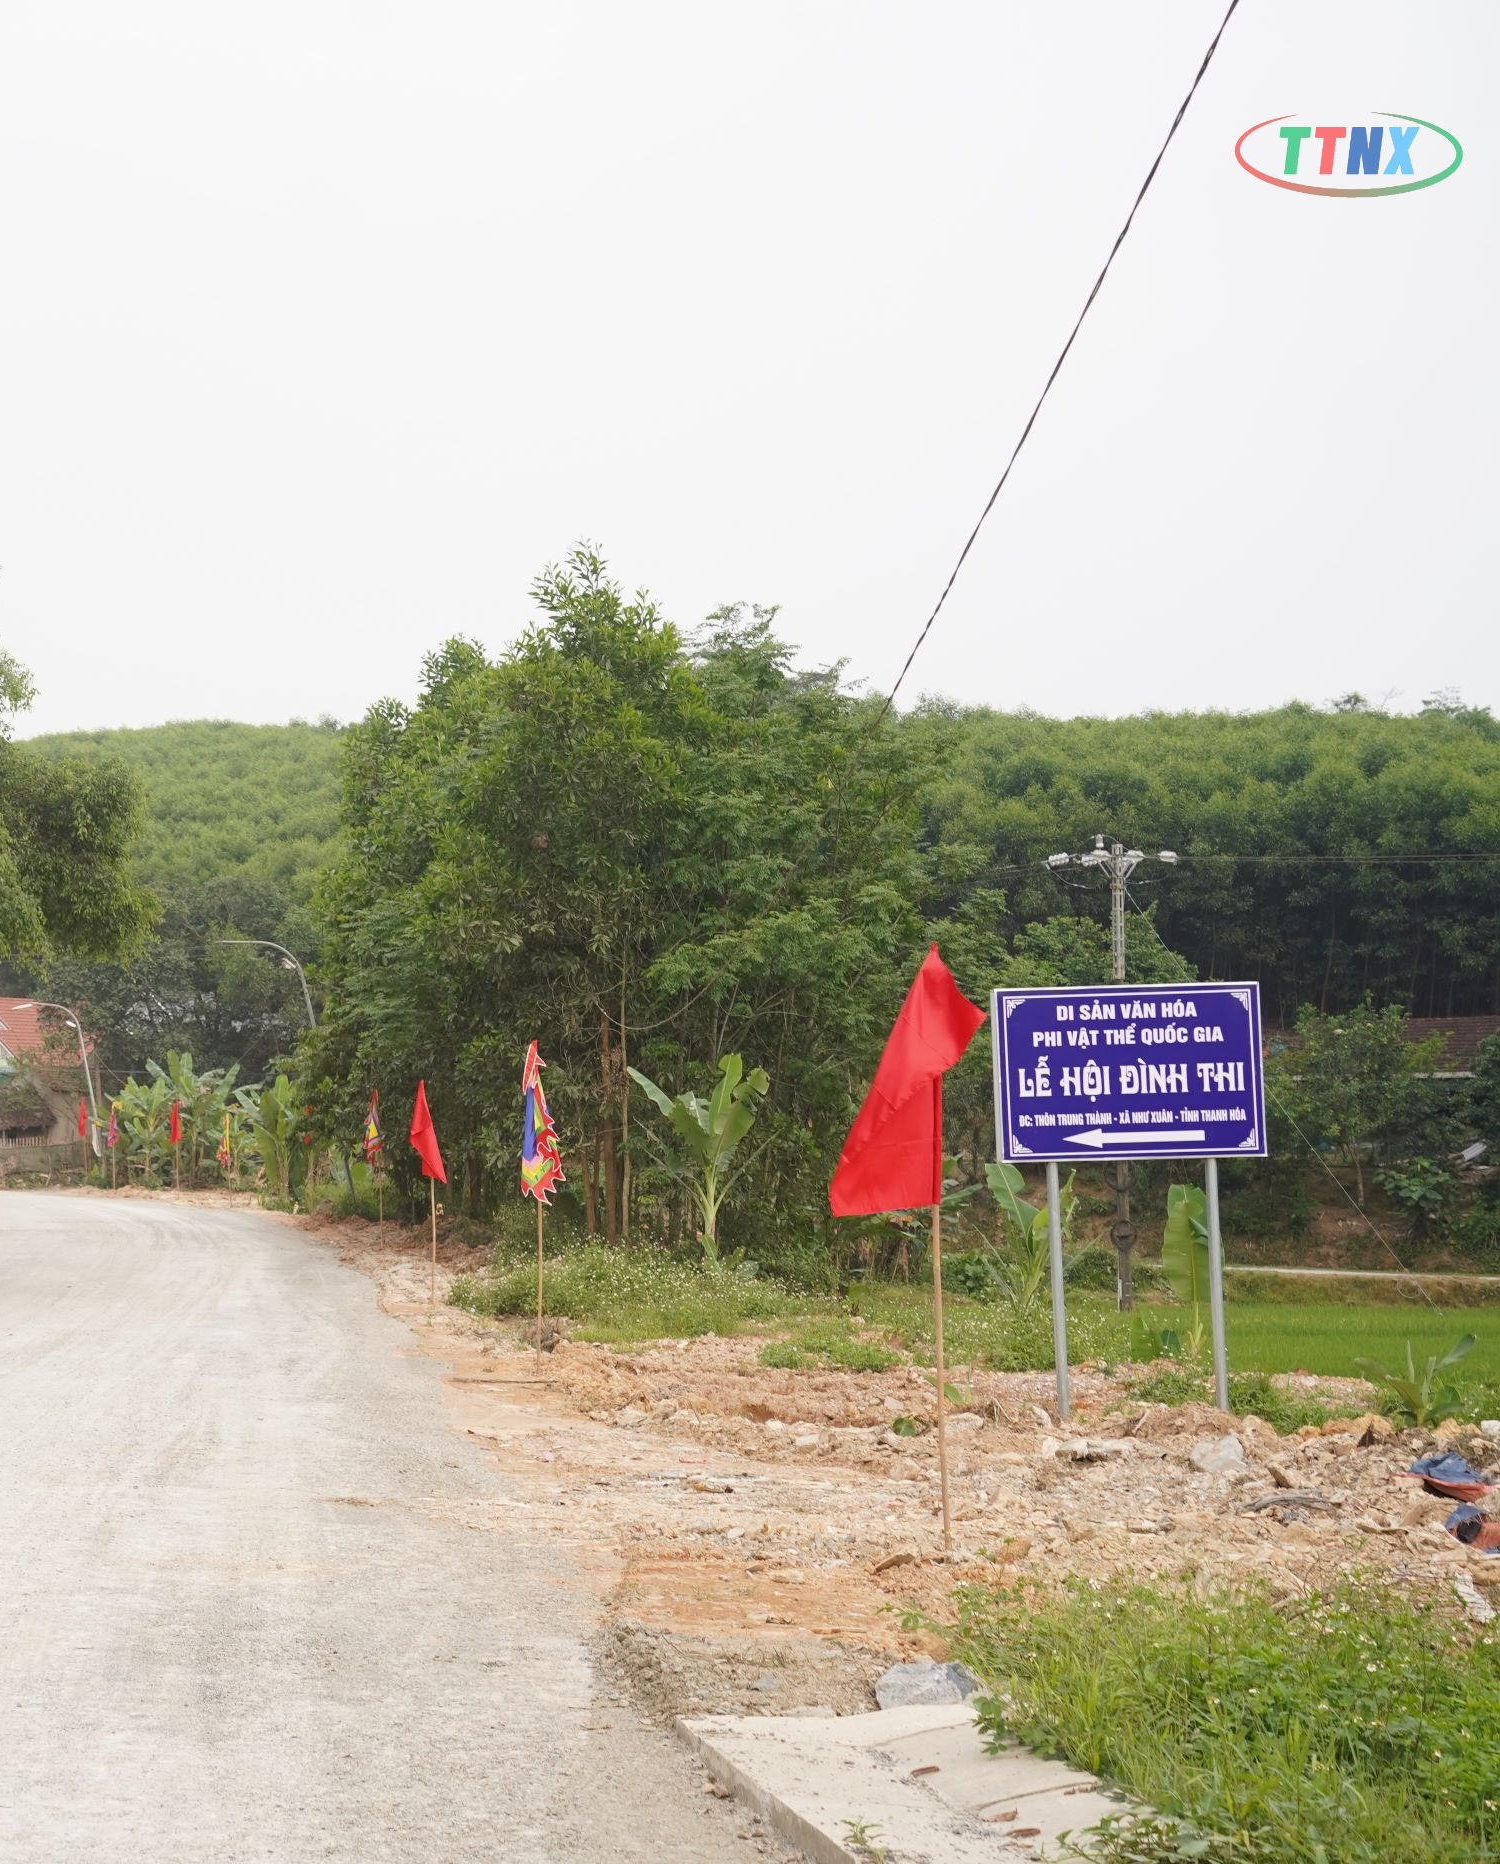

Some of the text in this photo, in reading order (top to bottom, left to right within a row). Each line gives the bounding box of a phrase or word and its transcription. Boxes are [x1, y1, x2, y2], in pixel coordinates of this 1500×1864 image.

[1056, 999, 1197, 1021] DI SẢN VĂN HÓA
[1033, 1022, 1224, 1049] PHI VẬT THỂ QUỐC GIA
[1018, 1055, 1245, 1102] LỄ HỘI ĐÌNH THI
[1019, 1114, 1033, 1127] ĐC:
[1034, 1111, 1057, 1126] THÔN
[1057, 1113, 1084, 1126] TRUNG
[1085, 1110, 1112, 1125] THÀNH
[1132, 1111, 1150, 1123] NHƯ
[1151, 1109, 1173, 1122] XUÂN
[1180, 1107, 1200, 1122] TỈNH
[1201, 1109, 1228, 1121] THANH
[1229, 1107, 1246, 1121] HÓA
